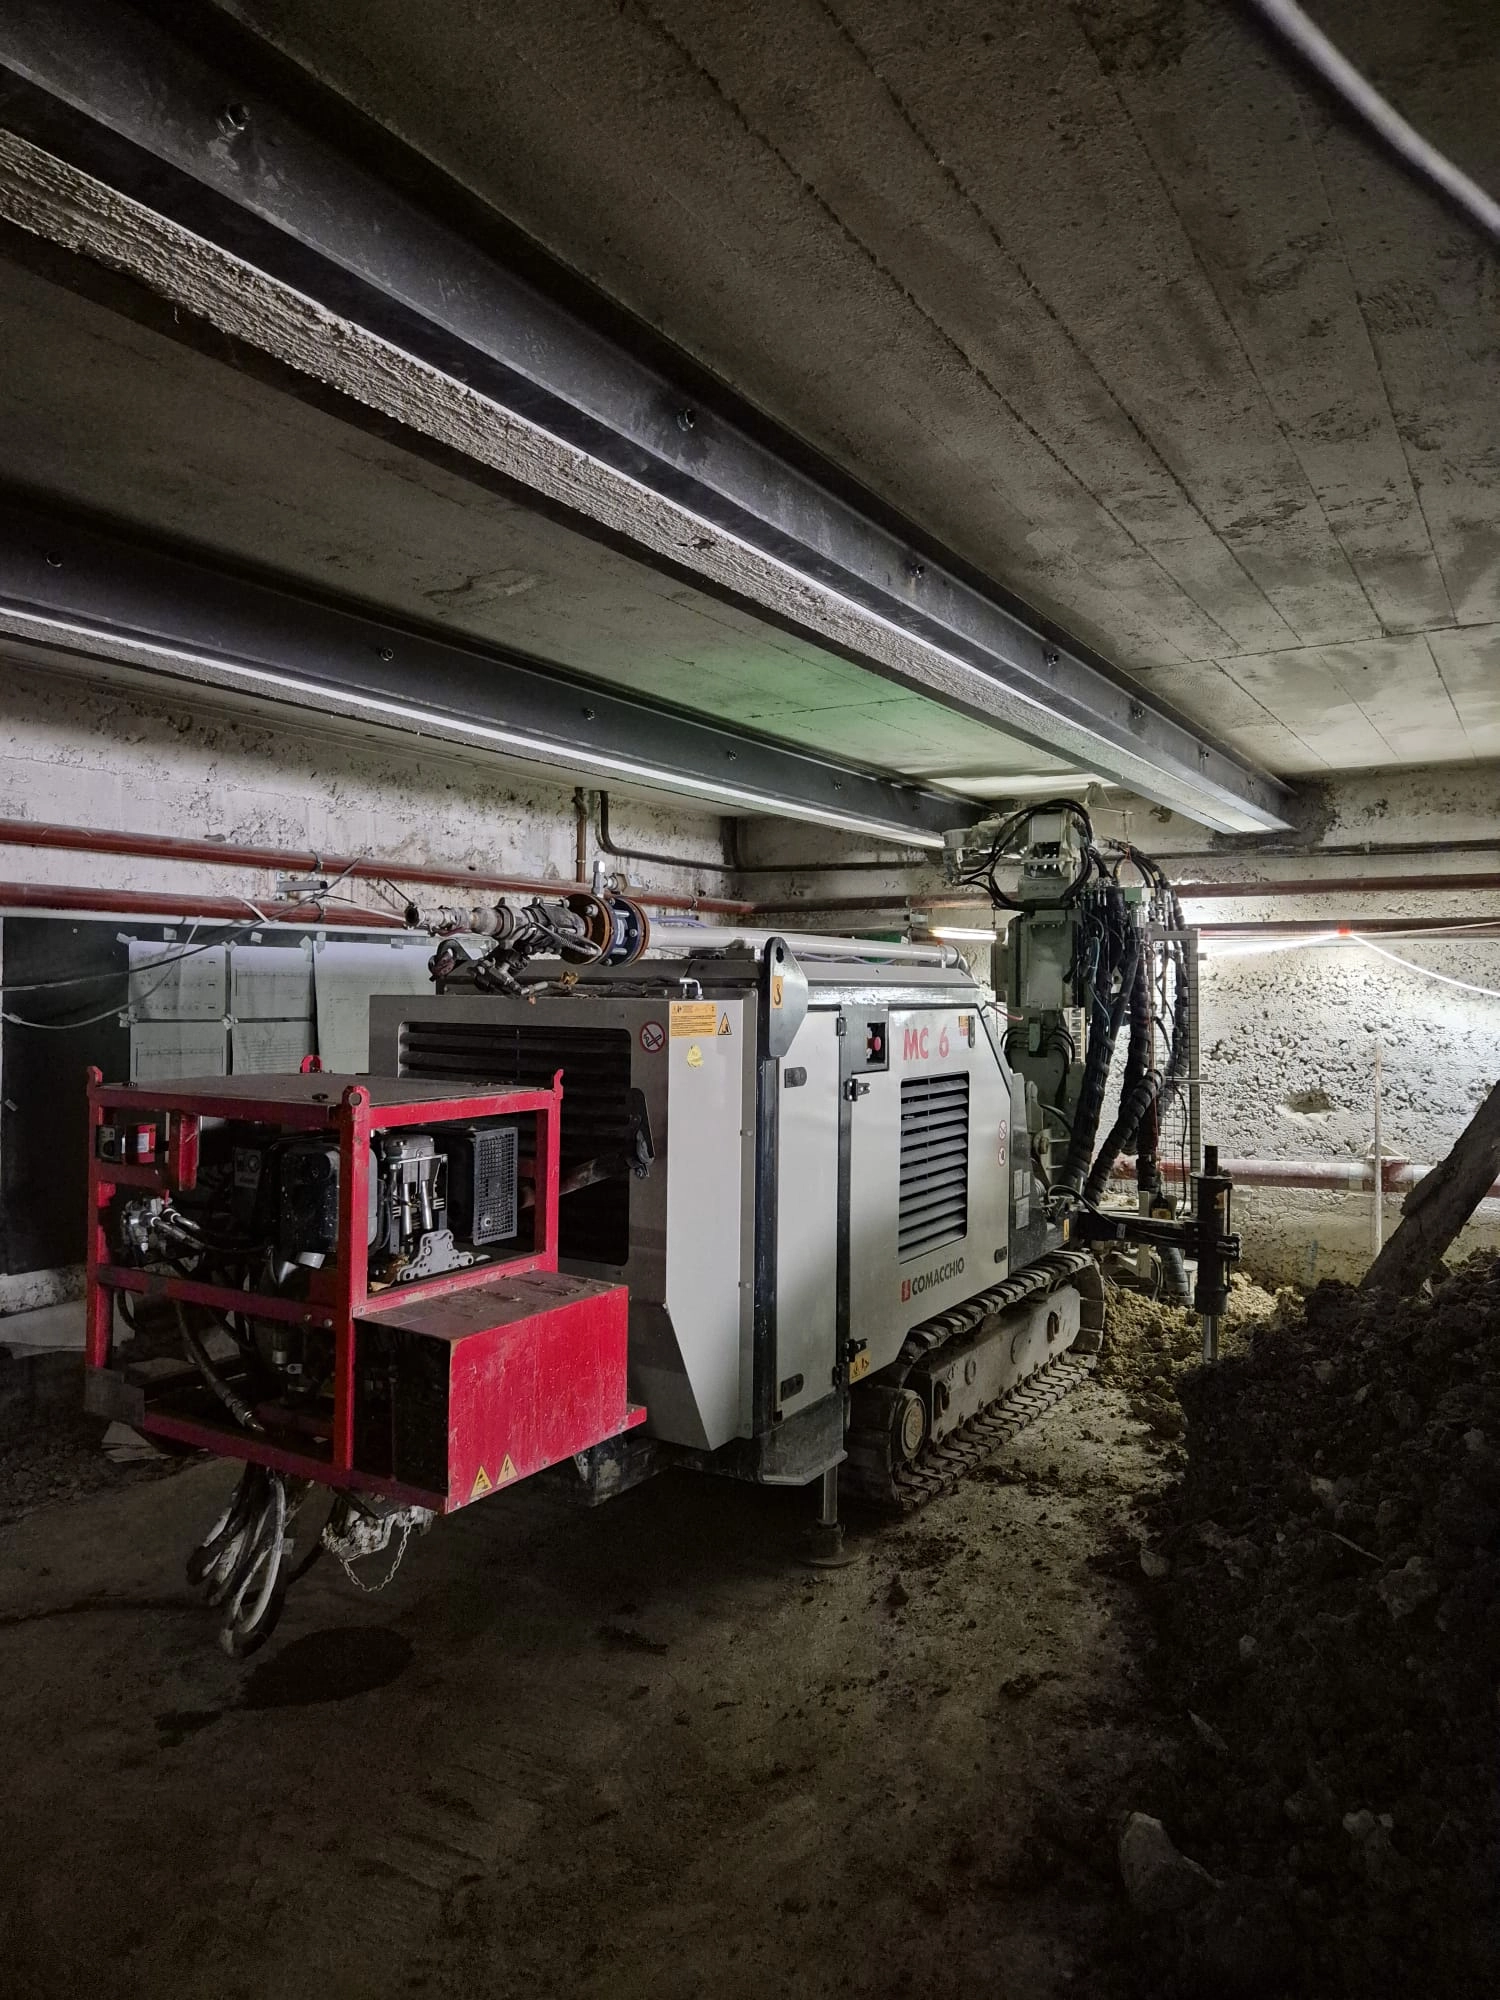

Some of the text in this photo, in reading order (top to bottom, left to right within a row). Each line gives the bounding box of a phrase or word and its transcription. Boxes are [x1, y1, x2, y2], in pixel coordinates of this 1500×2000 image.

[903, 1026, 949, 1060] MC 6
[912, 1257, 965, 1296] COMACCHIO
